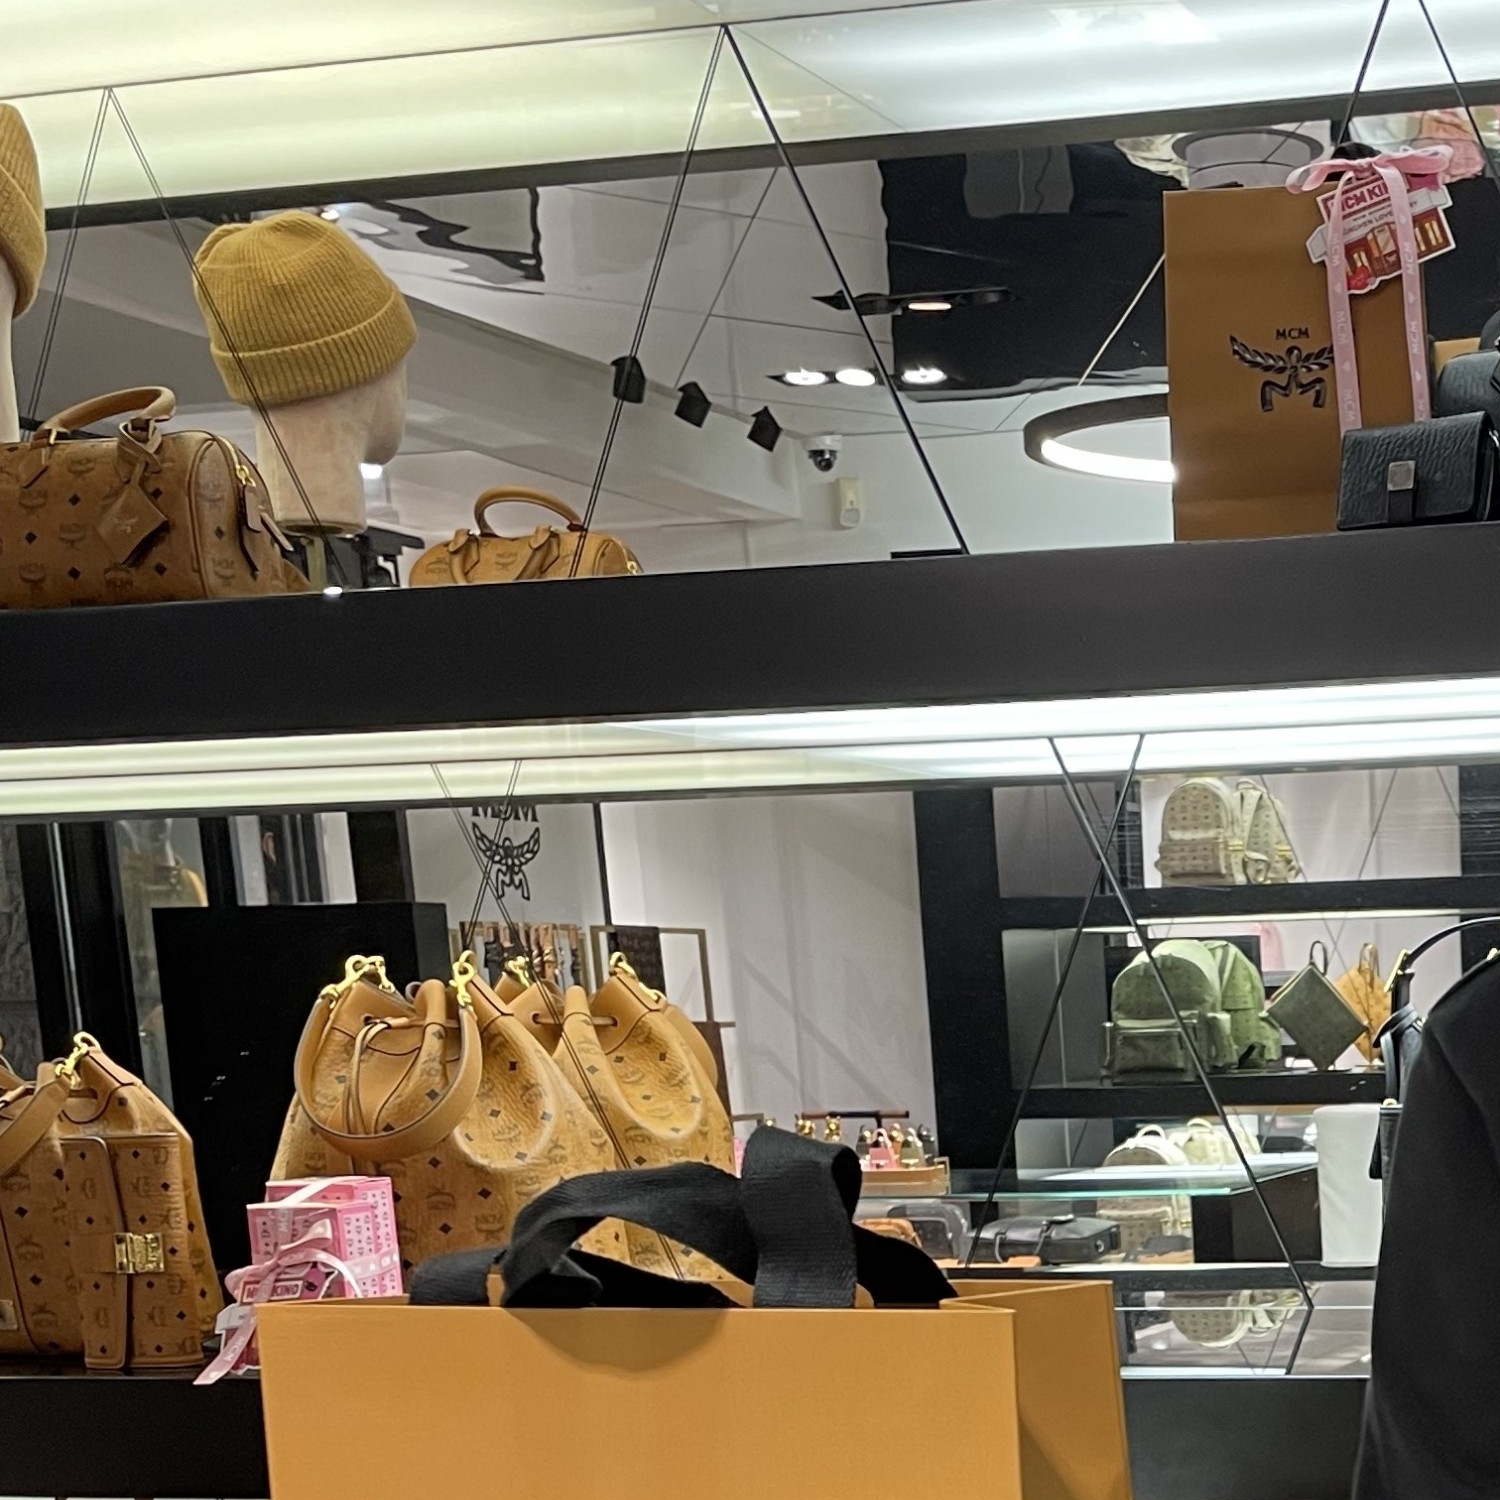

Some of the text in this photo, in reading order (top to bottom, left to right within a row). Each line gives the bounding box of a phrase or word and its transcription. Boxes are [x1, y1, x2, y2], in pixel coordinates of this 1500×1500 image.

[1275, 327, 1310, 340] MCM
[1335, 310, 1350, 345] MCM
[1408, 321, 1419, 354] MCM
[223, 1336, 245, 1362] MCM
